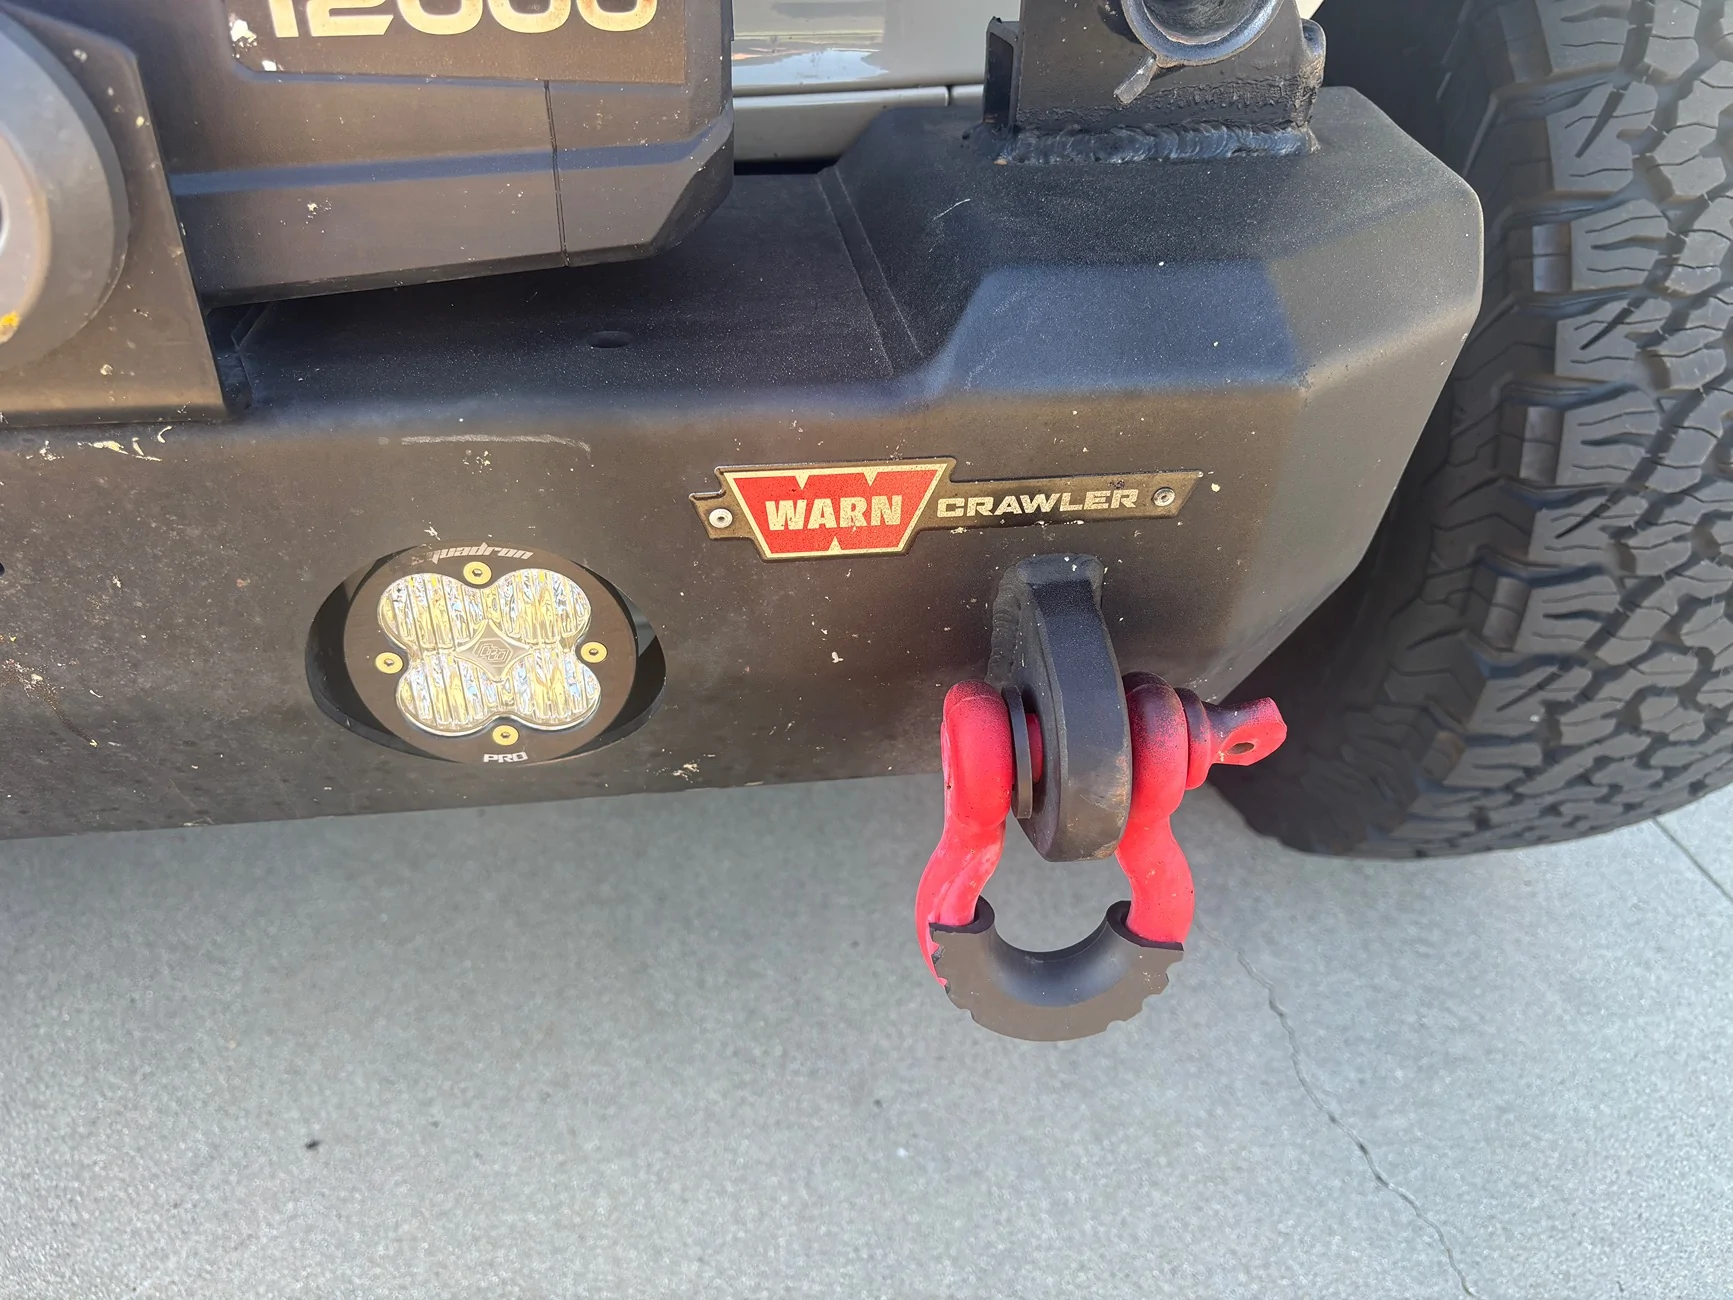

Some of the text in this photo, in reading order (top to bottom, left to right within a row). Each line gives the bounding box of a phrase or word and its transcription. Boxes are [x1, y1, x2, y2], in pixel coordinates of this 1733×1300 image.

[765, 489, 1139, 531] WARN CRAWLER
[483, 751, 529, 763] PRO
